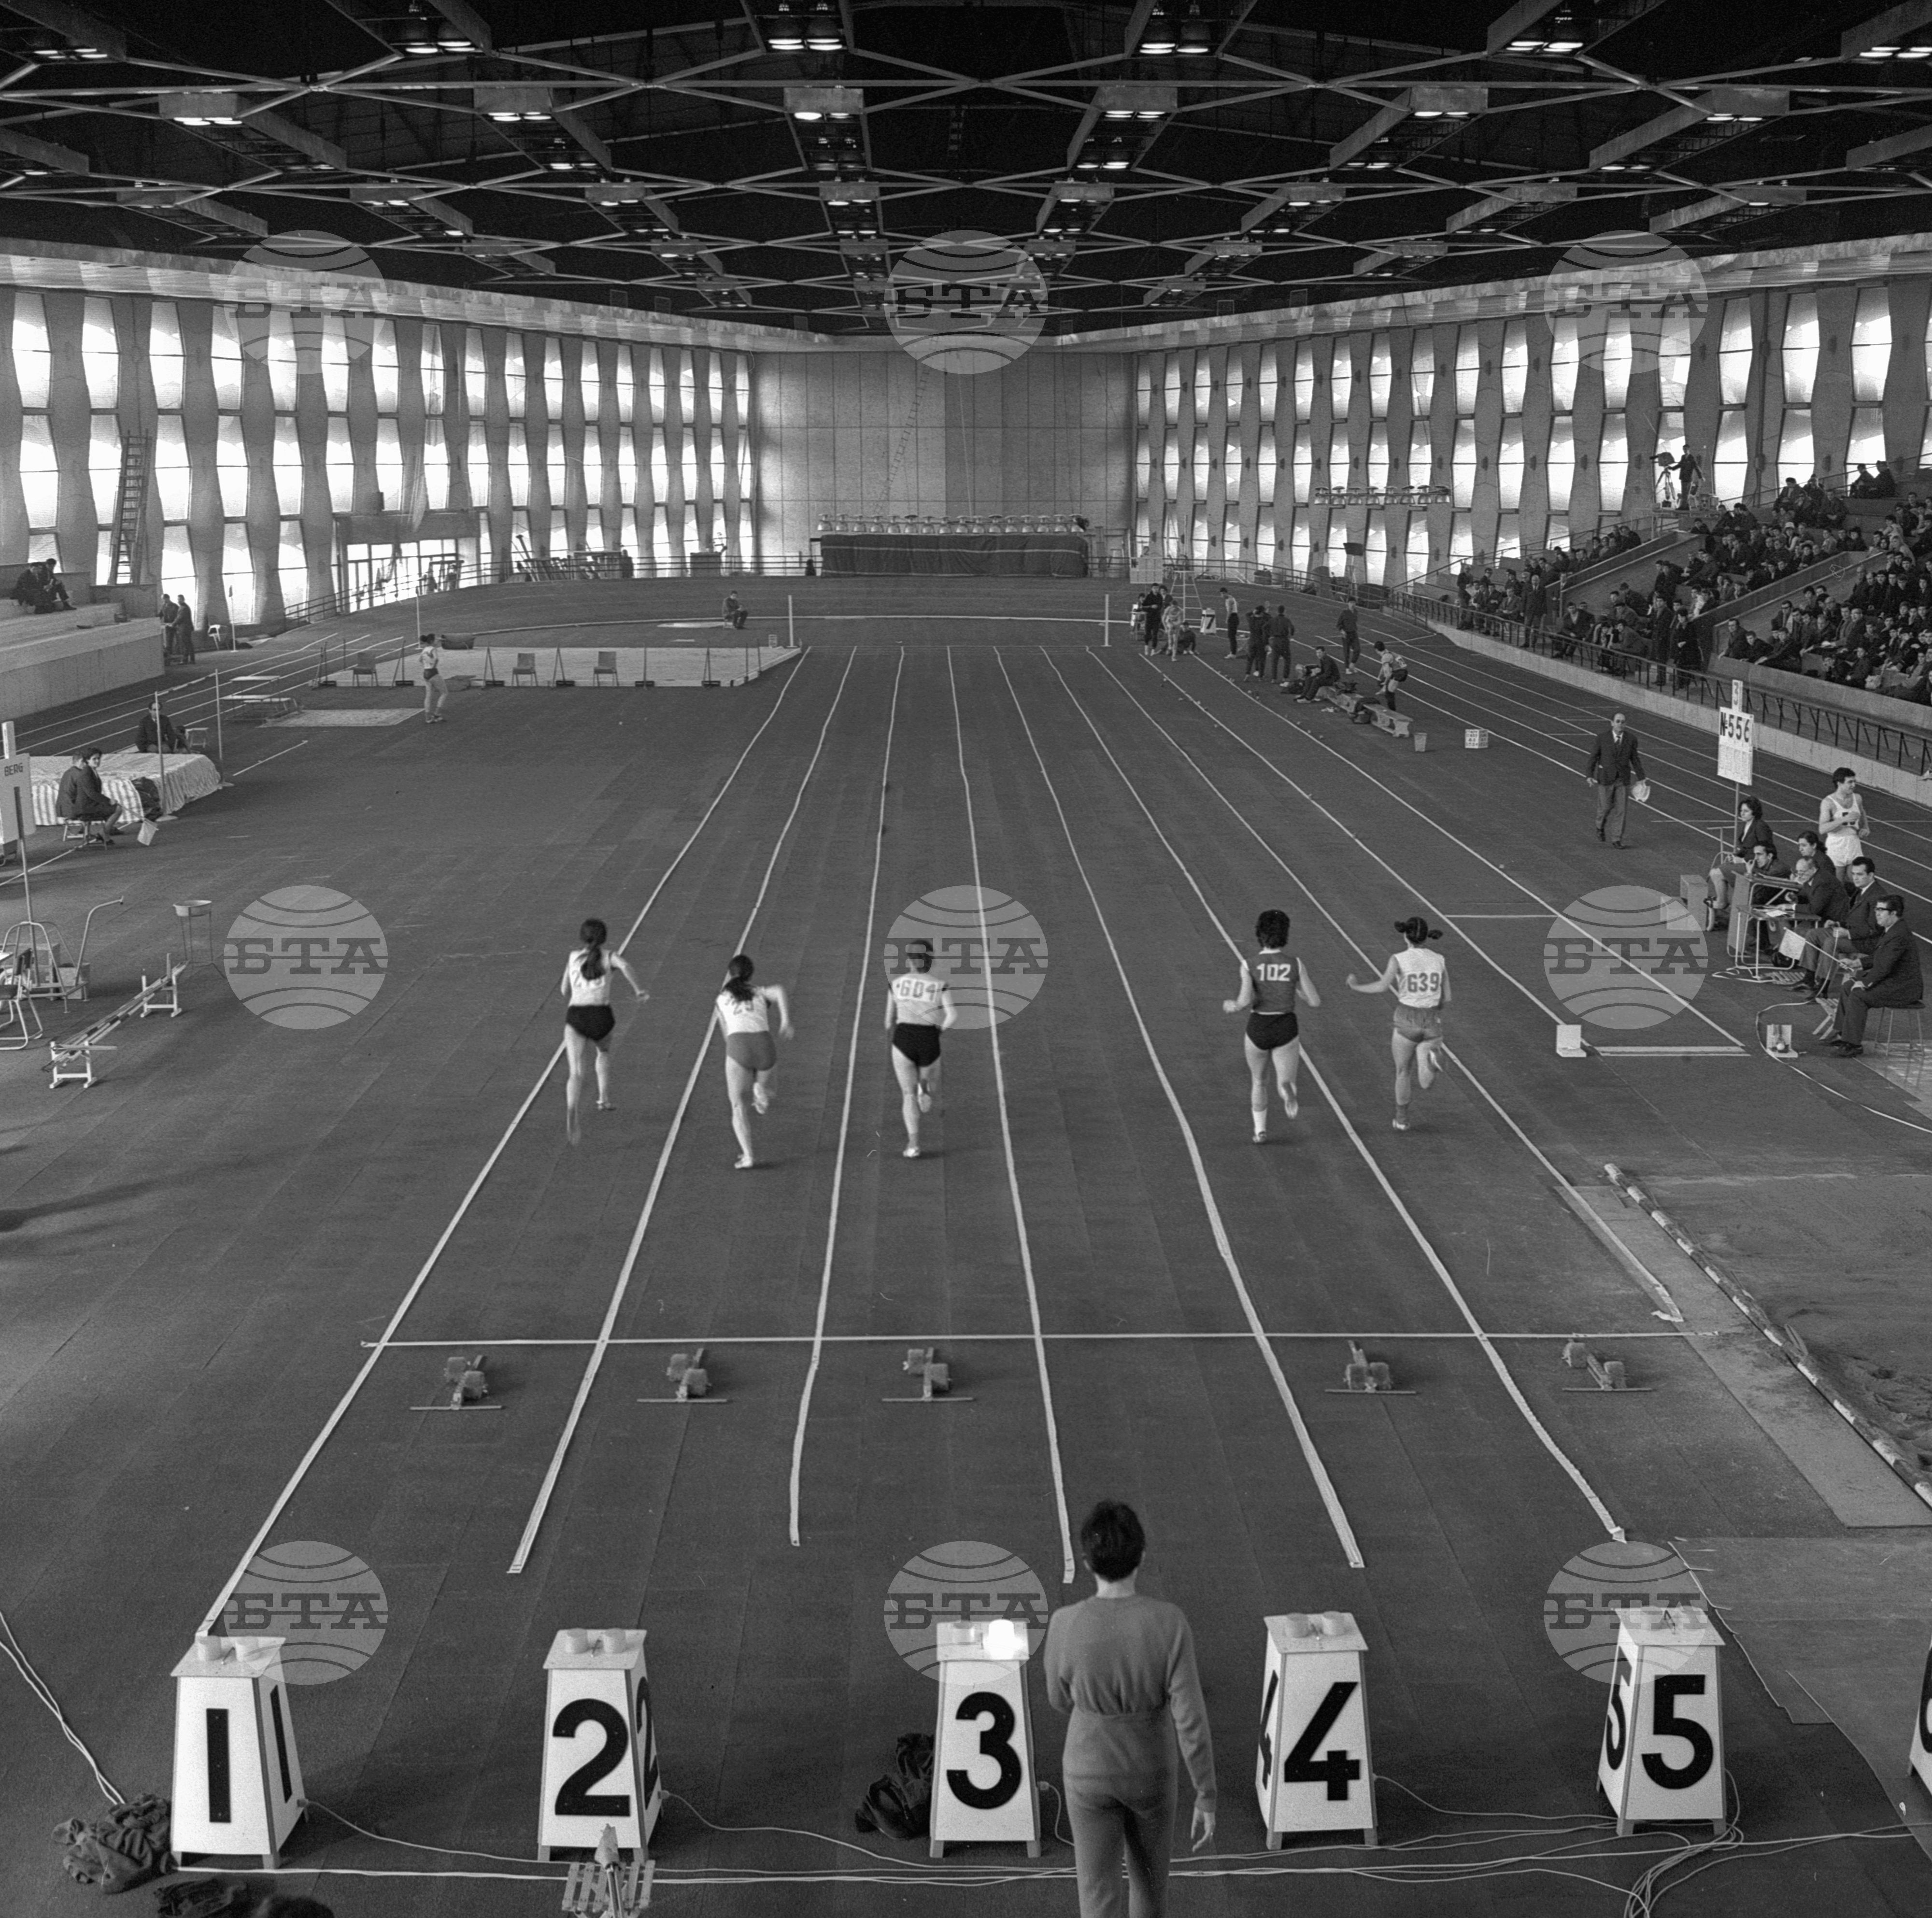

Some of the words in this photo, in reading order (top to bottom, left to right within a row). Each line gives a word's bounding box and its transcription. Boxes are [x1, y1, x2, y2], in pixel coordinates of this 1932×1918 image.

[1206, 614, 1215, 629] 7
[4, 763, 24, 777] BERG
[1257, 963, 1291, 981] 102
[1407, 972, 1439, 993] 639
[206, 1708, 231, 1823] 1
[552, 1698, 631, 1817] 2
[946, 1691, 1022, 1810] 3
[1284, 1681, 1361, 1801] 4
[1641, 1674, 1714, 1790] 5
